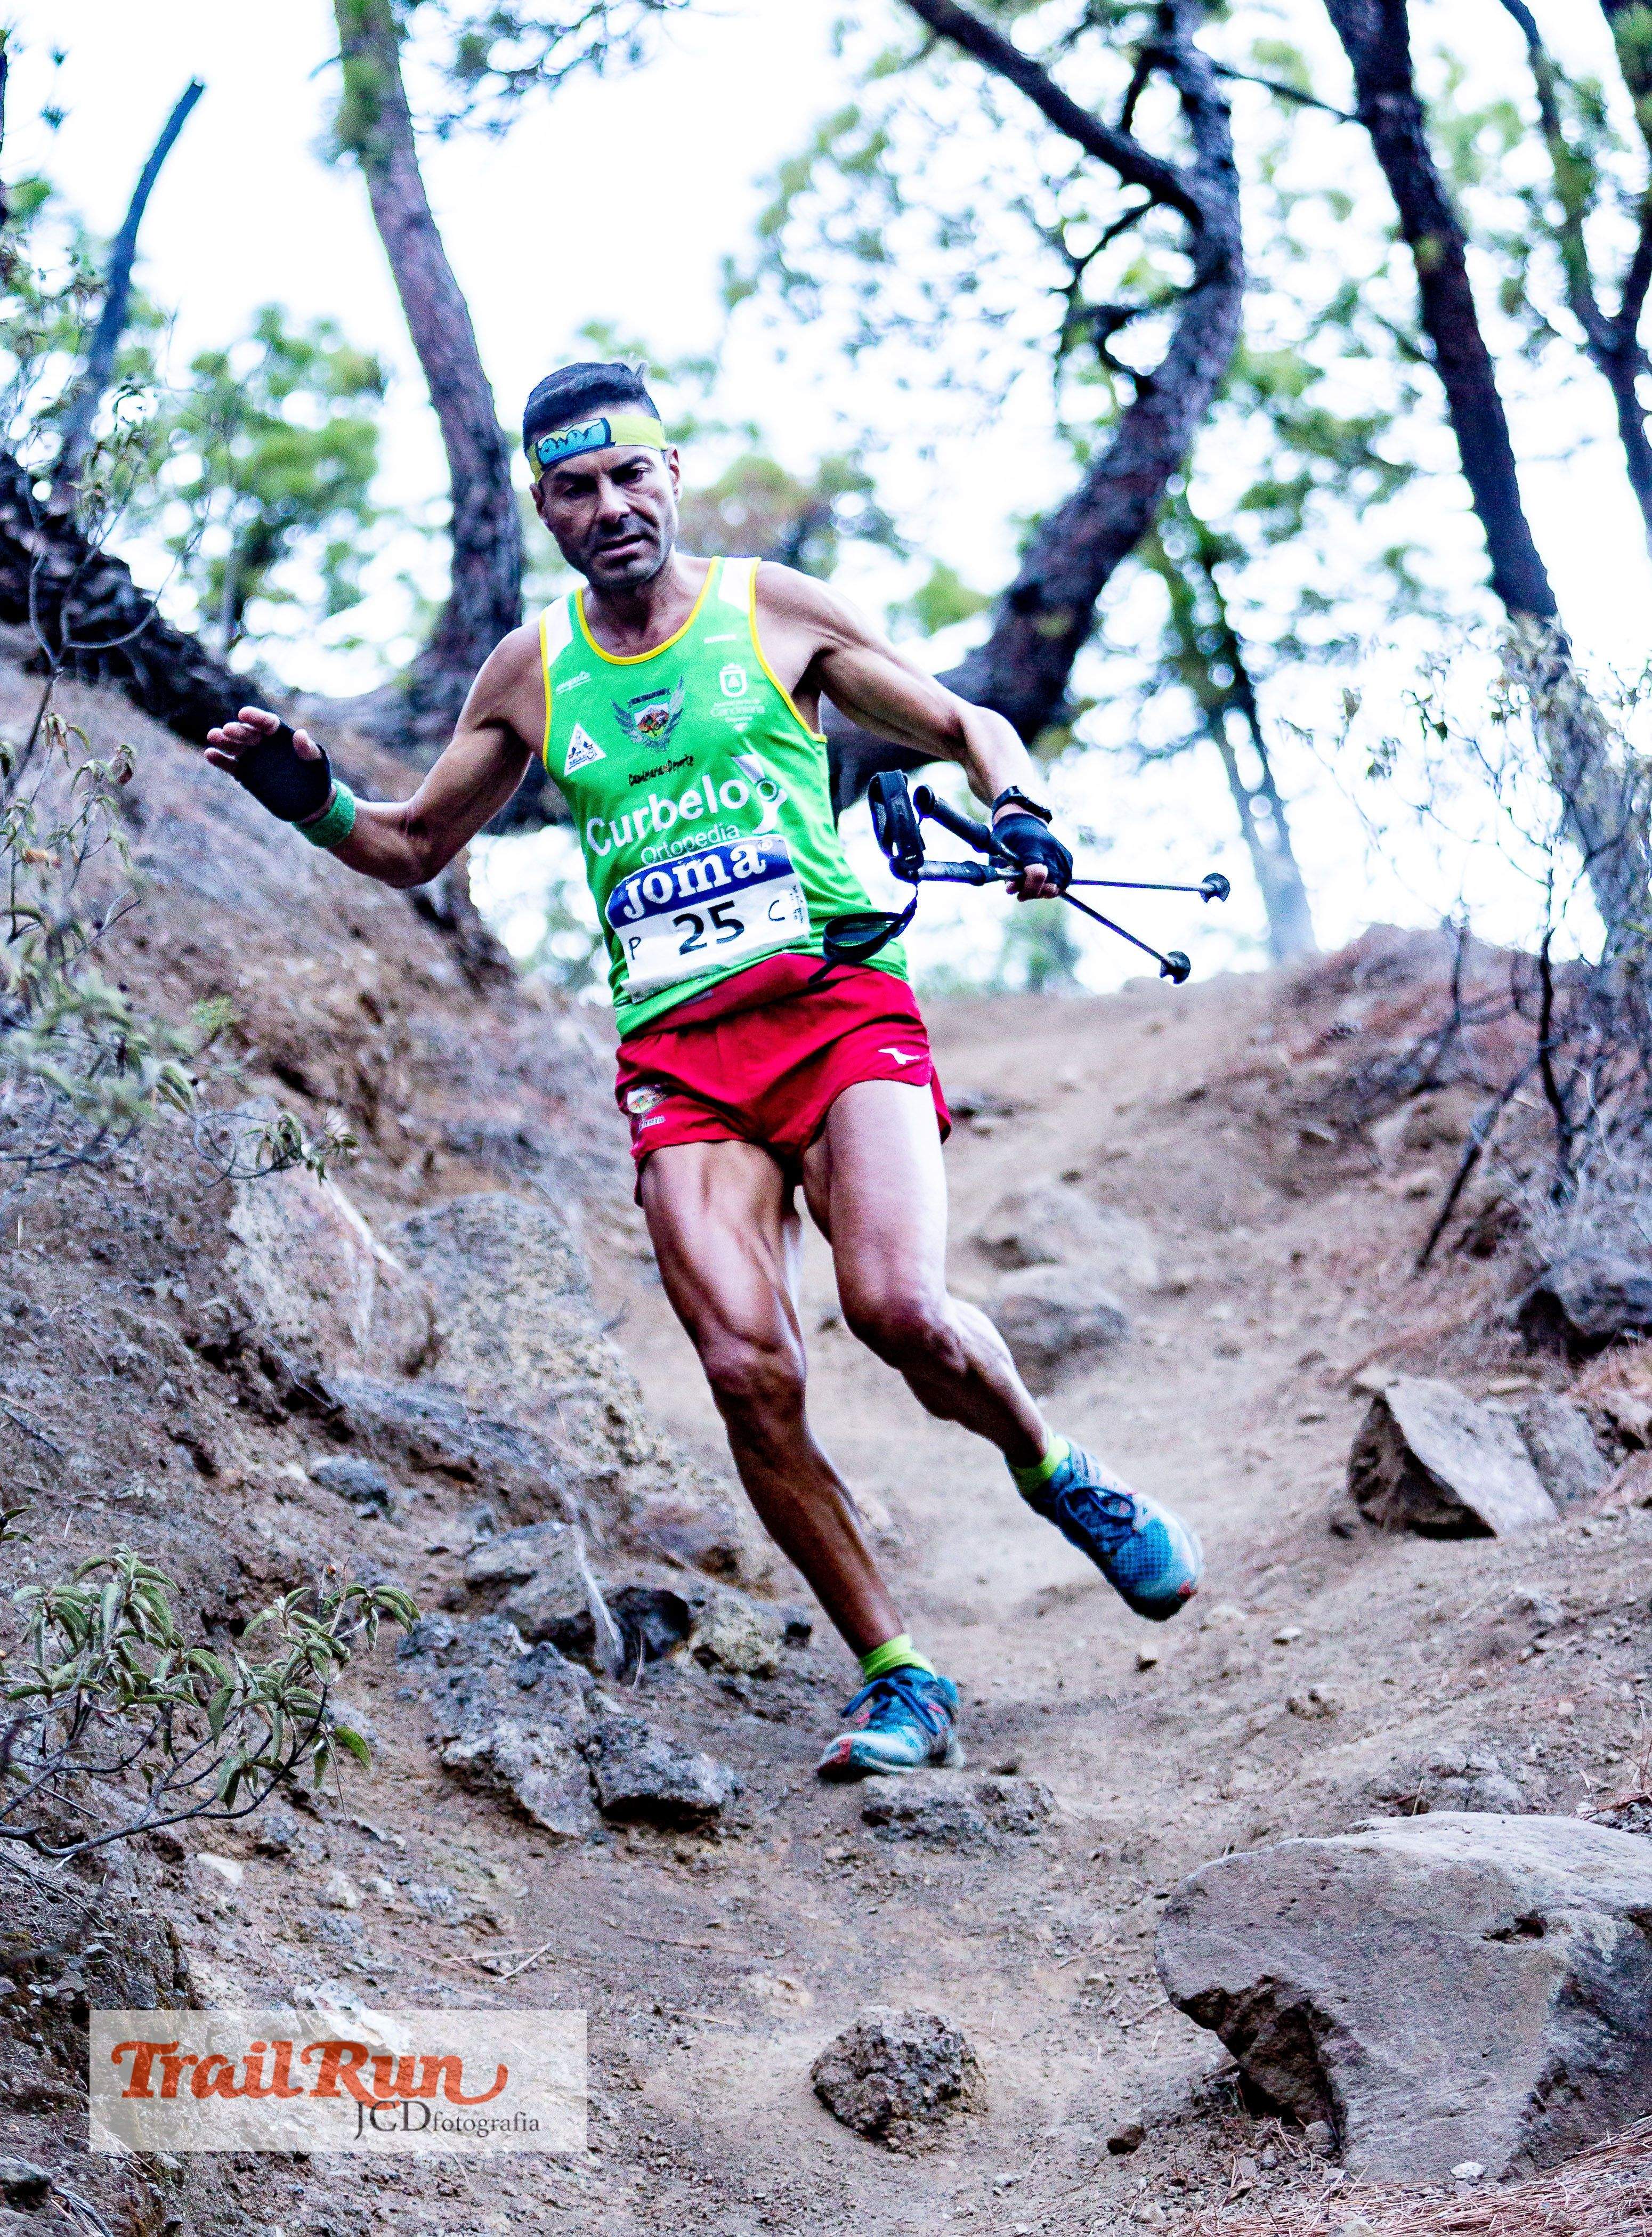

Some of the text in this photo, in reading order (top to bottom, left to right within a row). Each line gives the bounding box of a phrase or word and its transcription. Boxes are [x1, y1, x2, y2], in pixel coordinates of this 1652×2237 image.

[586, 774, 749, 857] Curbelo
[641, 822, 741, 865] Ortopedia
[628, 936, 641, 961] P
[673, 900, 745, 956] 25
[768, 899, 785, 922] C
